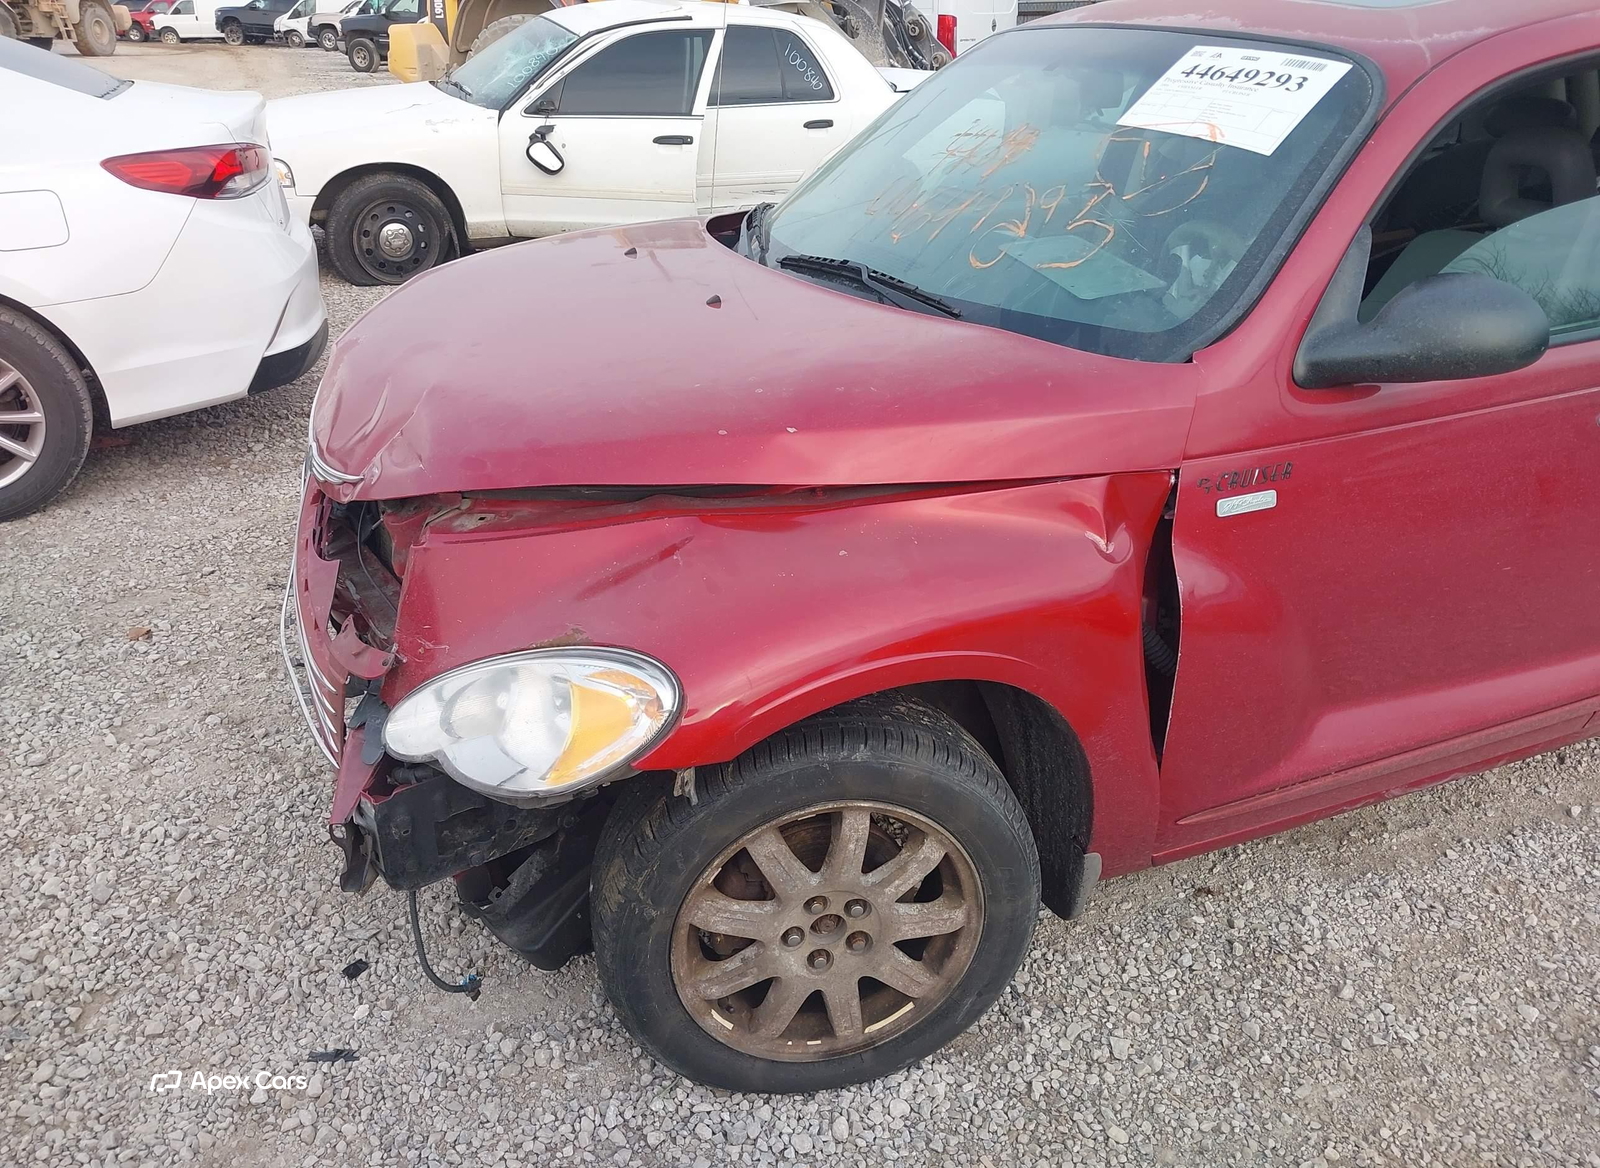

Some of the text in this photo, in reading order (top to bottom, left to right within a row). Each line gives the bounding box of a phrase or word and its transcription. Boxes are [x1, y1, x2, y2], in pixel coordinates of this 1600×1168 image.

[784, 43, 823, 90] 100840
[1181, 63, 1309, 93] 44649293
[1227, 82, 1259, 92] Insurance
[1216, 462, 1293, 491] CRUISER
